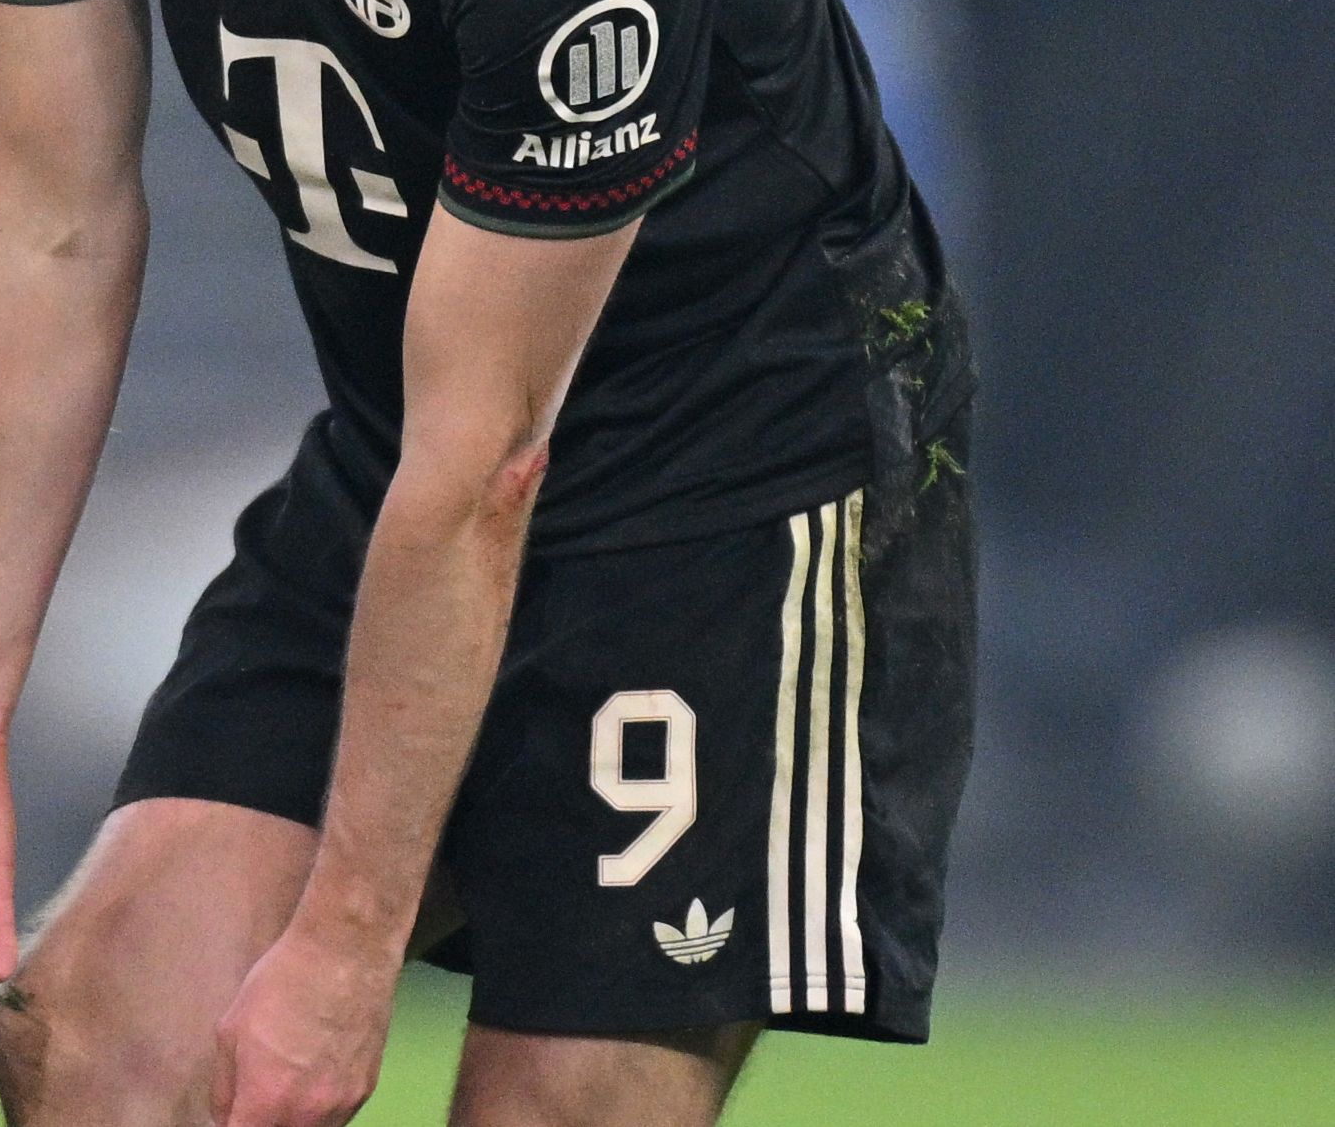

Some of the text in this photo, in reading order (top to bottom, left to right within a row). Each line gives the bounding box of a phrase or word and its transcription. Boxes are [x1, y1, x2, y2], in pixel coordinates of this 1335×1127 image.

[219, 17, 408, 274] T
[512, 112, 661, 169] Allianz
[590, 689, 697, 887] 9
